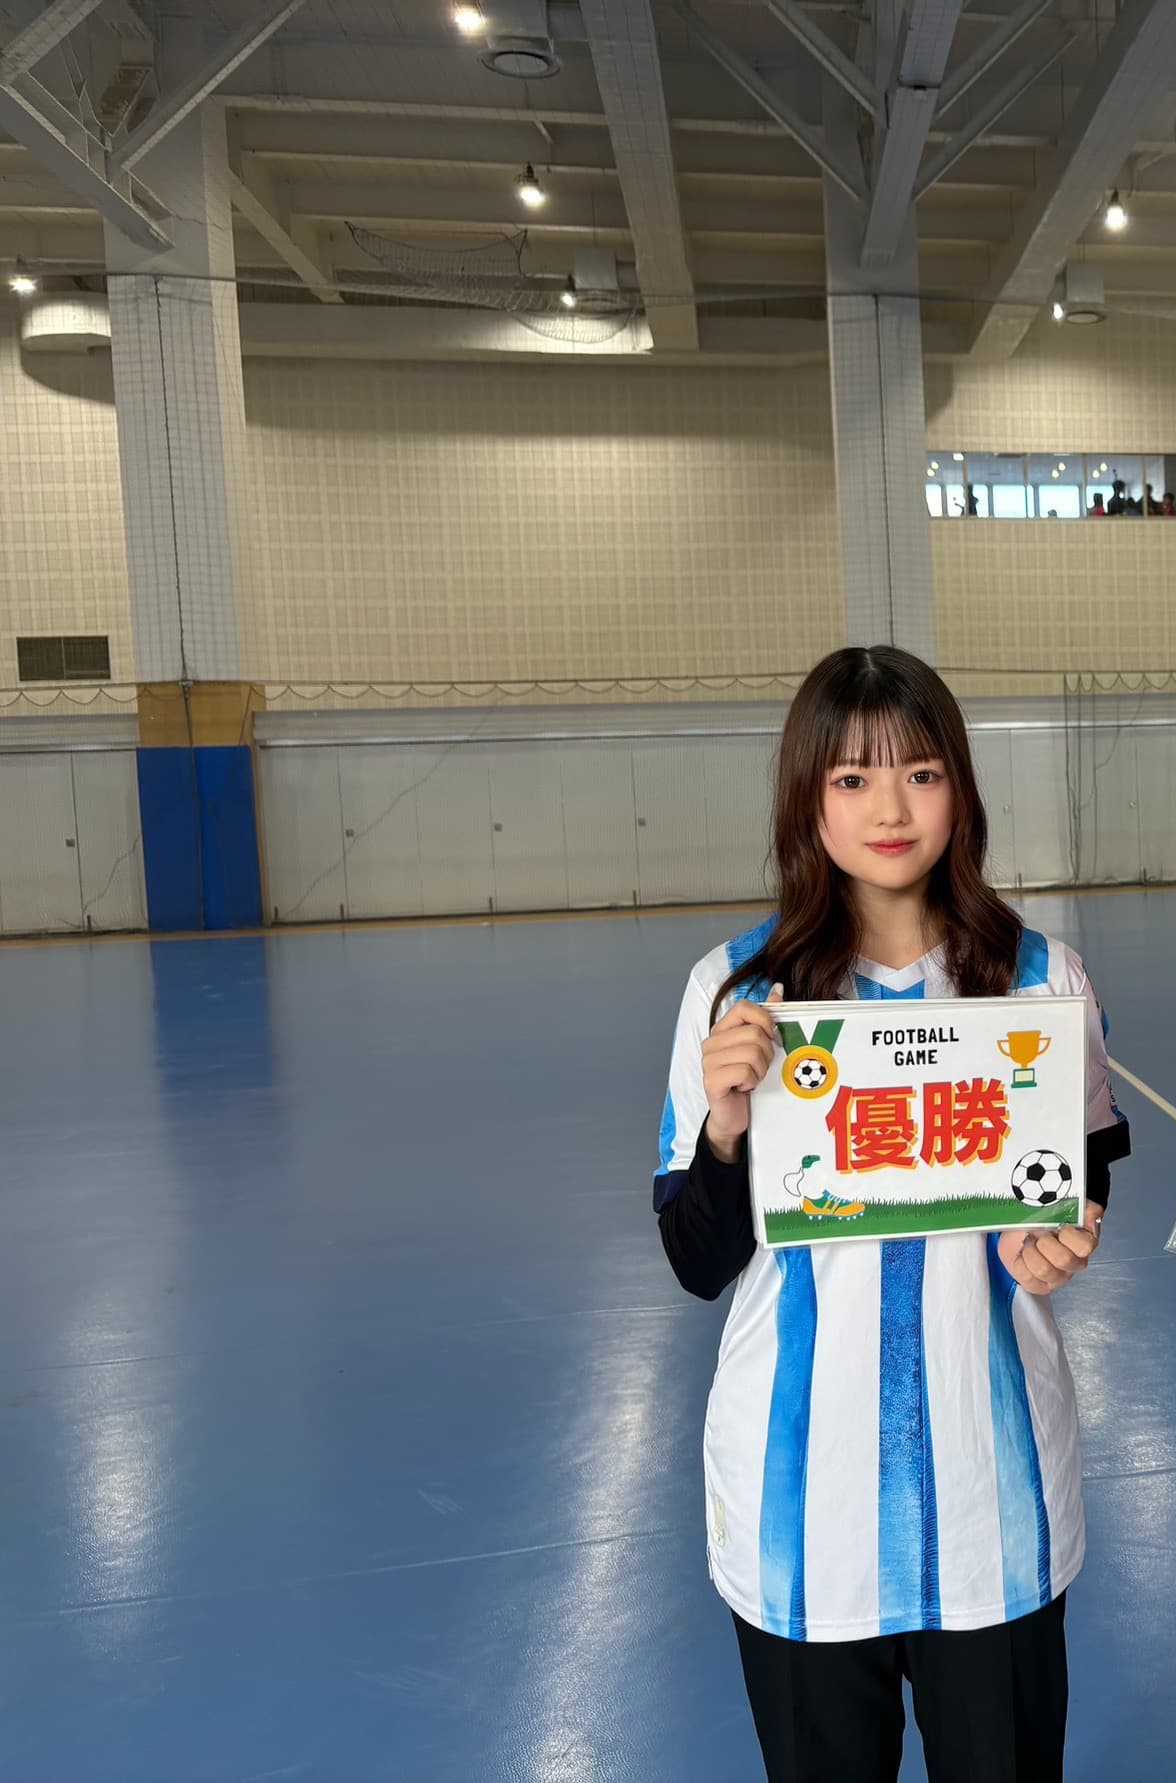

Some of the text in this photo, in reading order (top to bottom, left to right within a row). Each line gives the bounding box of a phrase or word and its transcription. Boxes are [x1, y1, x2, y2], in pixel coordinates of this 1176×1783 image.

[872, 1027, 959, 1045] FOOTBALL
[894, 1049, 938, 1066] GAME
[825, 1077, 1010, 1174] 優勝
